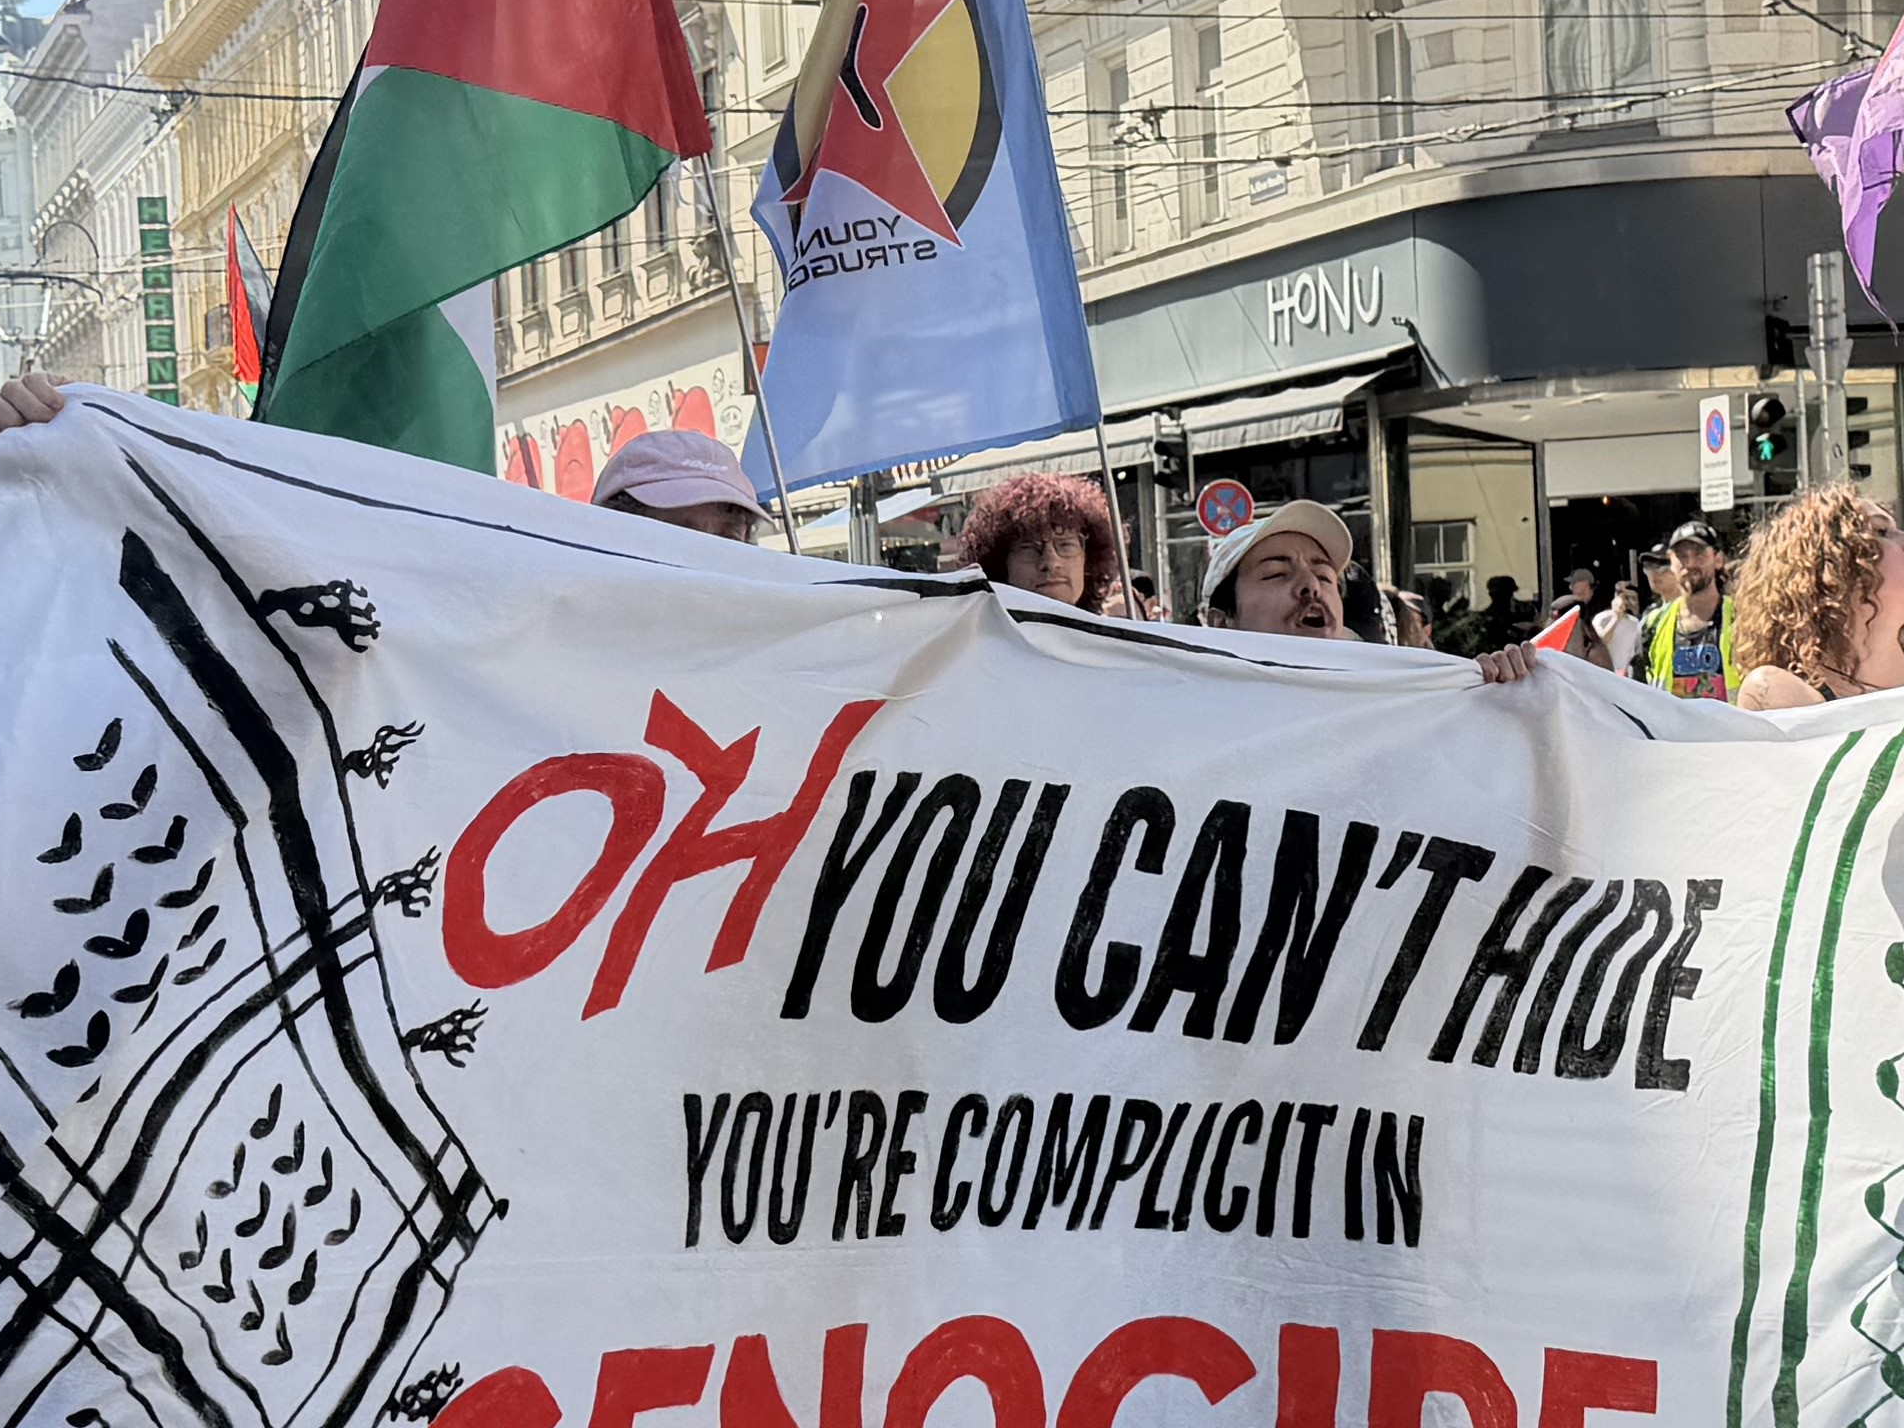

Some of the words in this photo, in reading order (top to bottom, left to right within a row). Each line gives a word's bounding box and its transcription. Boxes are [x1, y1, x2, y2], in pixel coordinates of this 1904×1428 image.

[1267, 259, 1380, 344] HONU
[442, 688, 886, 1021] OH
[780, 770, 1068, 1024] YOU
[1054, 785, 1496, 1052] CAN'T
[1427, 865, 1723, 1091] HIDE
[683, 1089, 928, 1248] YOU'RE
[931, 1092, 1338, 1237] COMPLICIT
[1345, 1107, 1424, 1248] IN
